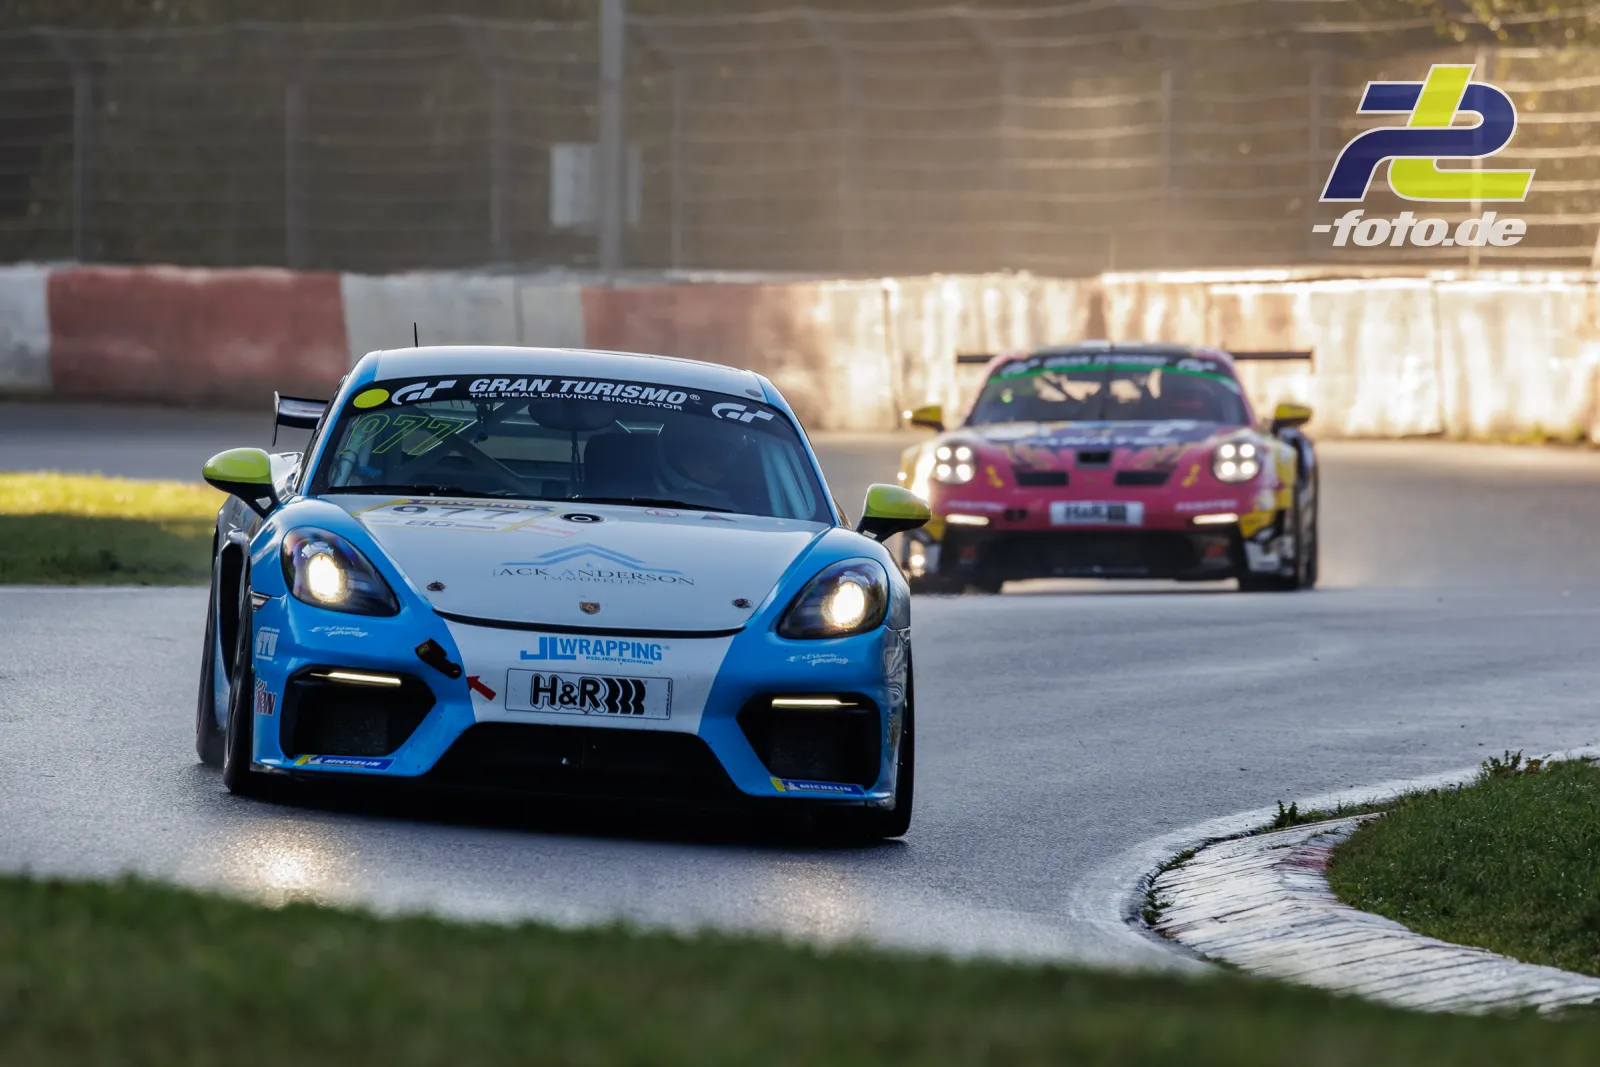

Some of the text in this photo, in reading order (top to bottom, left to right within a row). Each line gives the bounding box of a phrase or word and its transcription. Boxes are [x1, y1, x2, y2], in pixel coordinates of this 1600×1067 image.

[469, 378, 553, 393] GRAN
[541, 392, 599, 401] DRIVING
[602, 396, 683, 412] SIMULATOR
[340, 413, 465, 456] 977
[393, 505, 520, 521] 977
[543, 576, 647, 586] IMMOBILIEN
[562, 568, 695, 587] ANDERSON
[559, 638, 662, 662] WRAPPING
[530, 673, 607, 714] H&R
[323, 758, 381, 767] MICHELIN
[800, 783, 852, 792] MICHELIN
